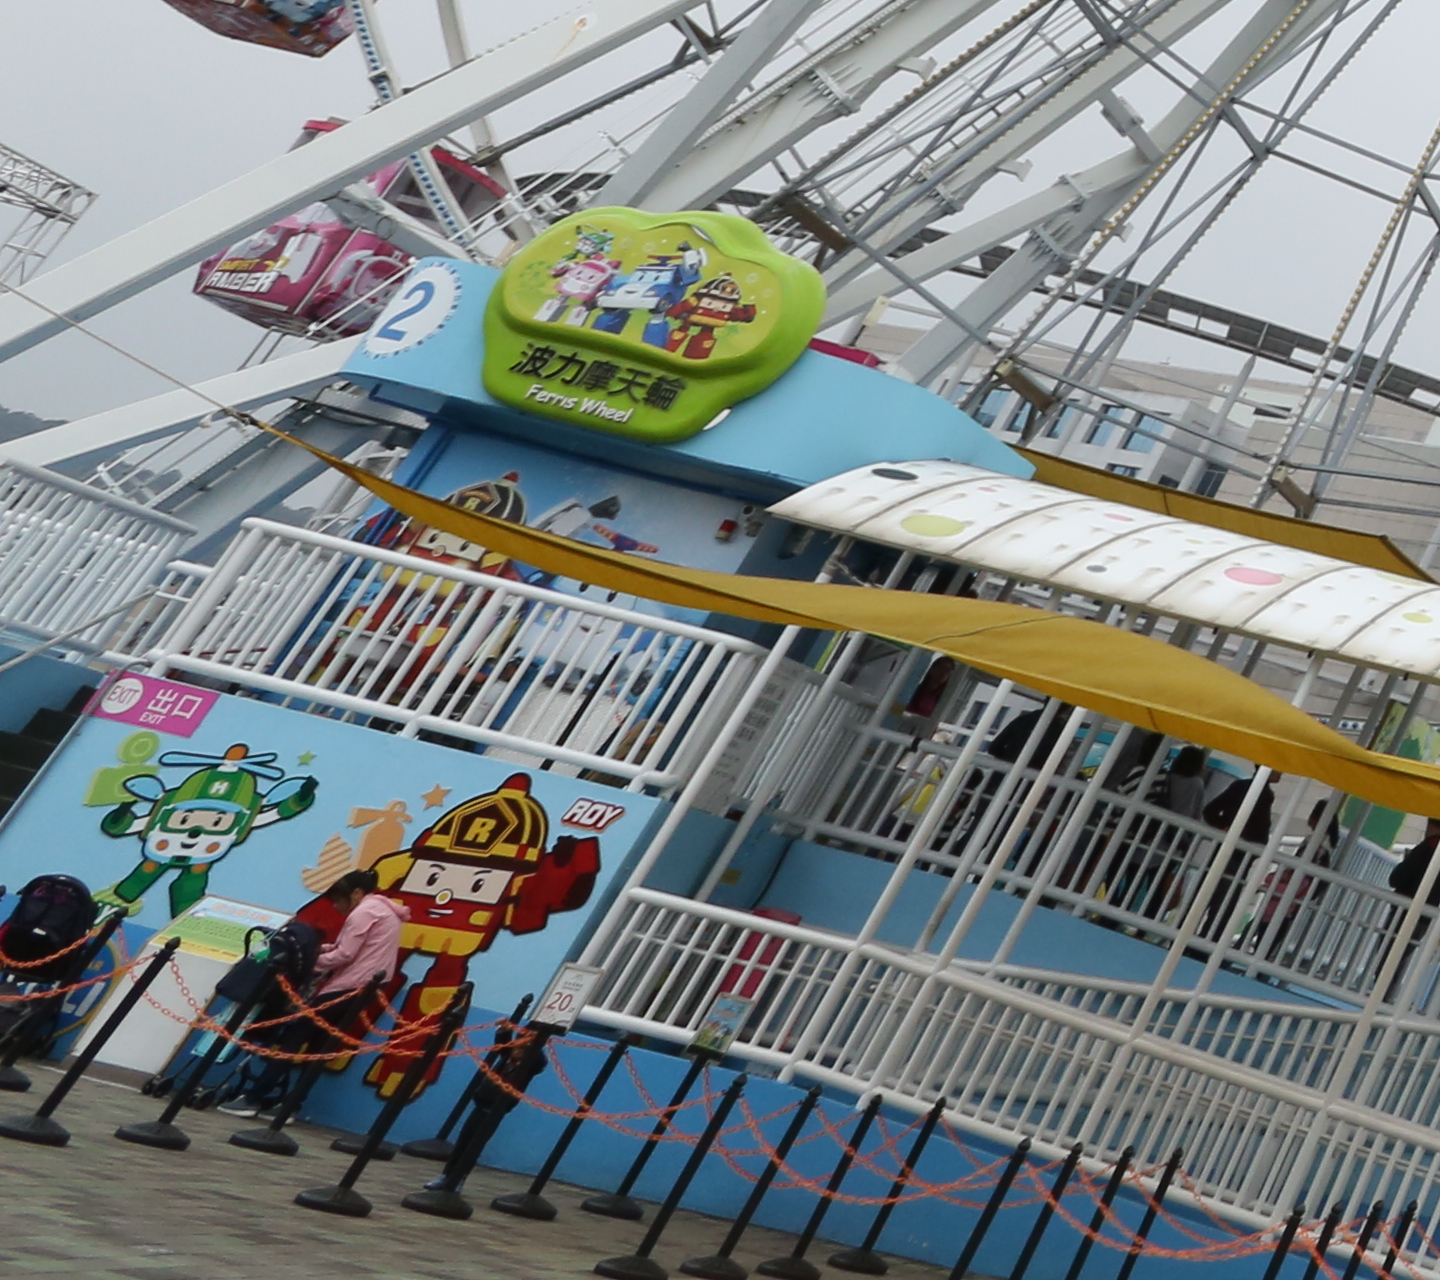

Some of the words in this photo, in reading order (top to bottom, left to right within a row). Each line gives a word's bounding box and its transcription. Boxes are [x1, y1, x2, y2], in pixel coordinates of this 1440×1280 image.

[206, 271, 281, 294] AMBER
[374, 280, 436, 342] 2
[508, 342, 688, 412] 波力摩天輪
[524, 383, 579, 410] Ferris
[579, 395, 635, 424] Wheel
[106, 684, 140, 705] EXIT
[147, 688, 204, 720] 出口
[138, 711, 166, 725] EXIT
[209, 780, 230, 796] H
[562, 798, 624, 831] ROY
[463, 817, 497, 843] R
[545, 992, 573, 1012] 20
